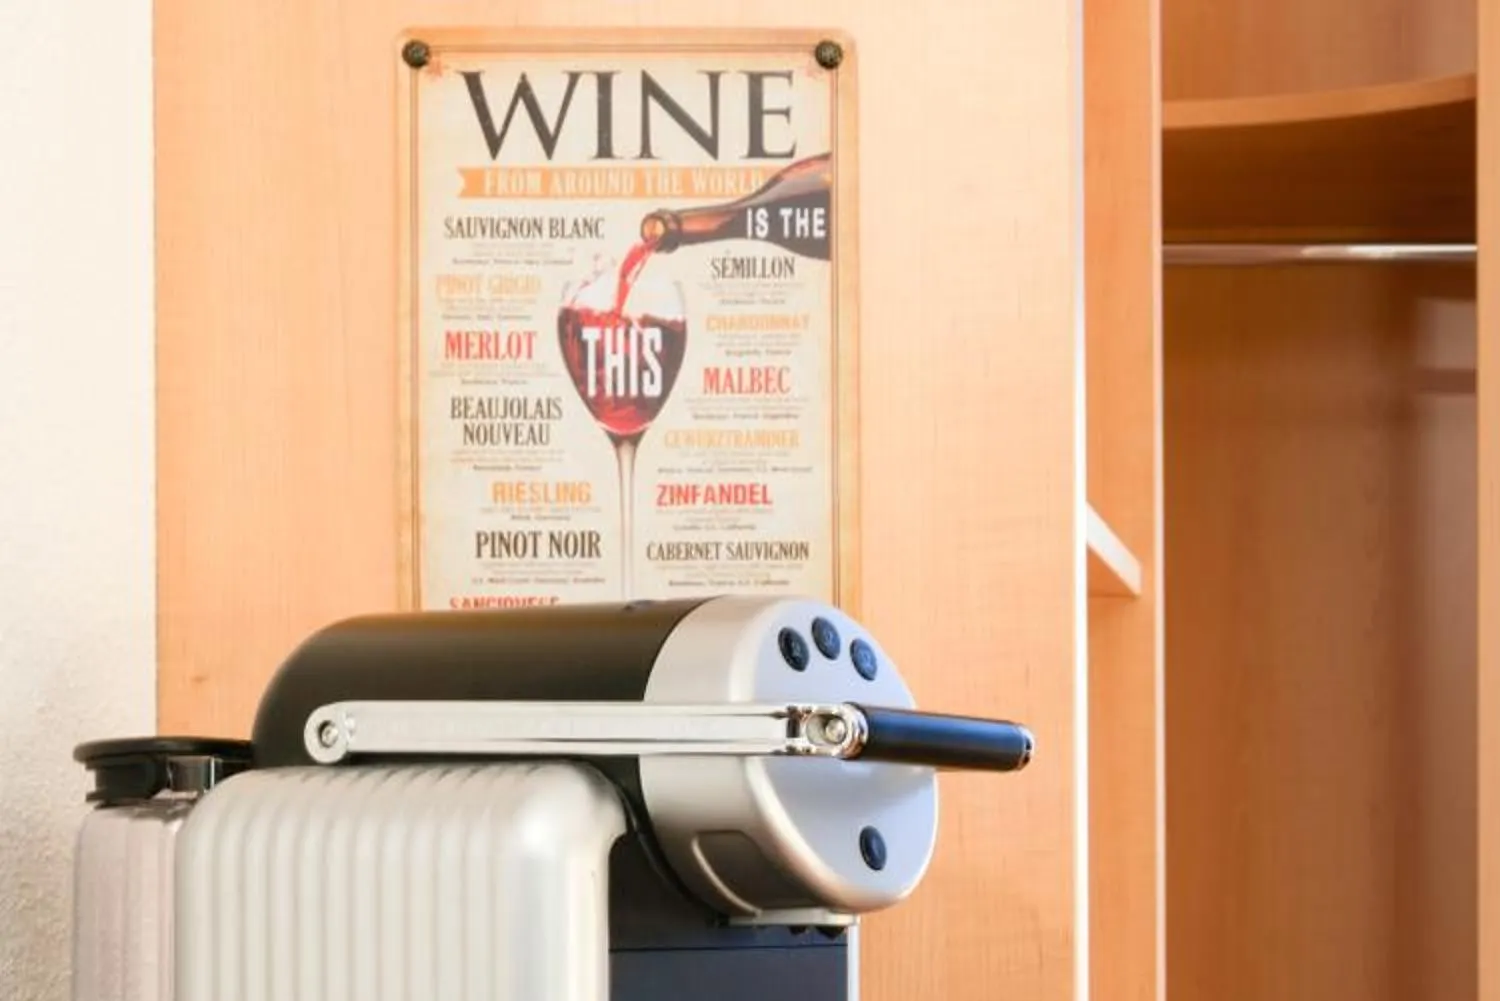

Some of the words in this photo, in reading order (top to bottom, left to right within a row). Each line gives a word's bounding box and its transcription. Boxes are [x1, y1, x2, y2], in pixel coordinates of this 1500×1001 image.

[456, 69, 796, 160] WINE
[485, 169, 542, 197] FROM
[552, 169, 636, 197] AROUND
[645, 169, 684, 197] THE
[444, 216, 543, 240] SAUVIGNON
[549, 216, 605, 240] BLANC
[746, 207, 769, 238] IS
[780, 207, 826, 238] THE
[445, 330, 537, 360] MERLOT
[581, 327, 662, 398] THIS
[703, 366, 791, 395] MALBEC
[450, 396, 563, 420] BEAUJOLAIS
[463, 422, 551, 446] NOUVEAU
[491, 481, 592, 504] RIESLING
[656, 483, 773, 506] ZINFANDEL
[475, 530, 542, 559] PINOT
[548, 530, 602, 559] NOIR
[646, 541, 722, 561] CABERNET
[725, 540, 809, 561] SAUVIGNON
